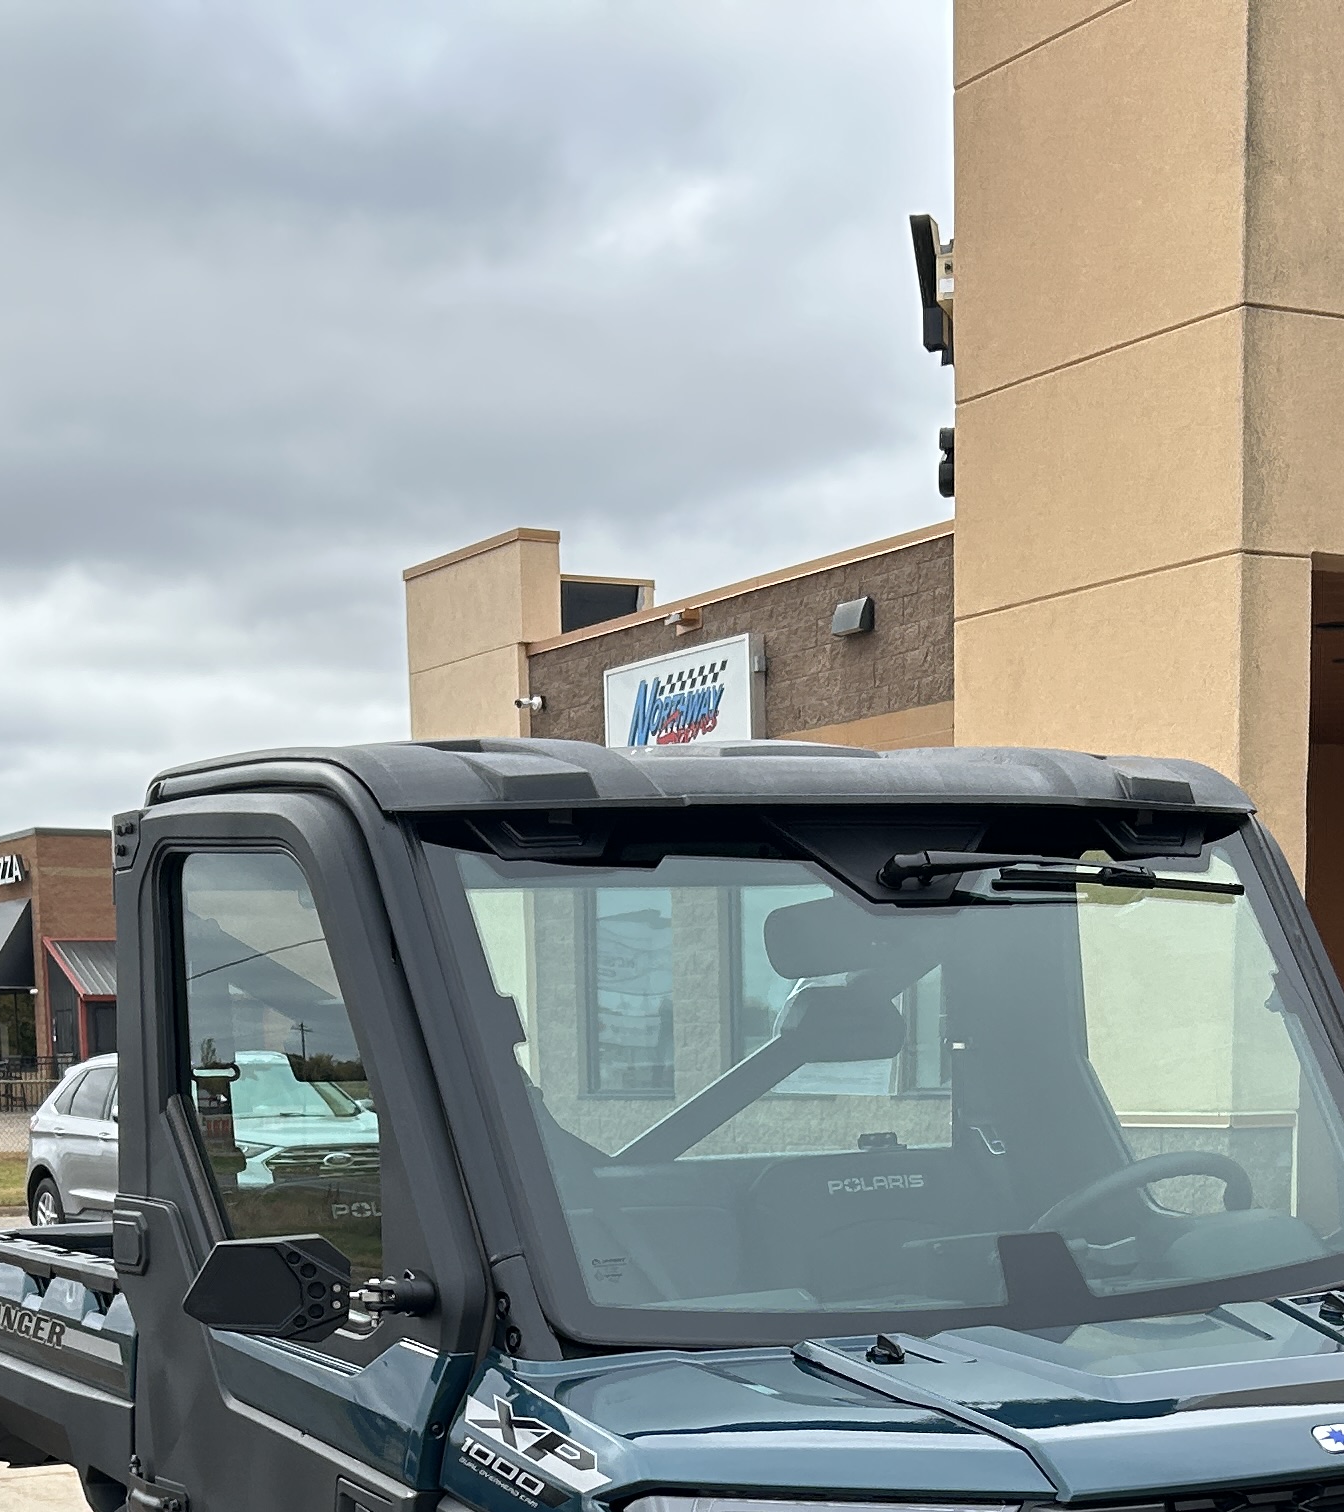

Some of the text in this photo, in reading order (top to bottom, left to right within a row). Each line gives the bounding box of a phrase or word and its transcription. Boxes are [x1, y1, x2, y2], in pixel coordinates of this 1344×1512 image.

[827, 1174, 925, 1195] POLARIS
[465, 1393, 598, 1472] XP
[458, 1456, 539, 1509] DUAL OVERHEAD CAM
[460, 1436, 545, 1496] 1000
